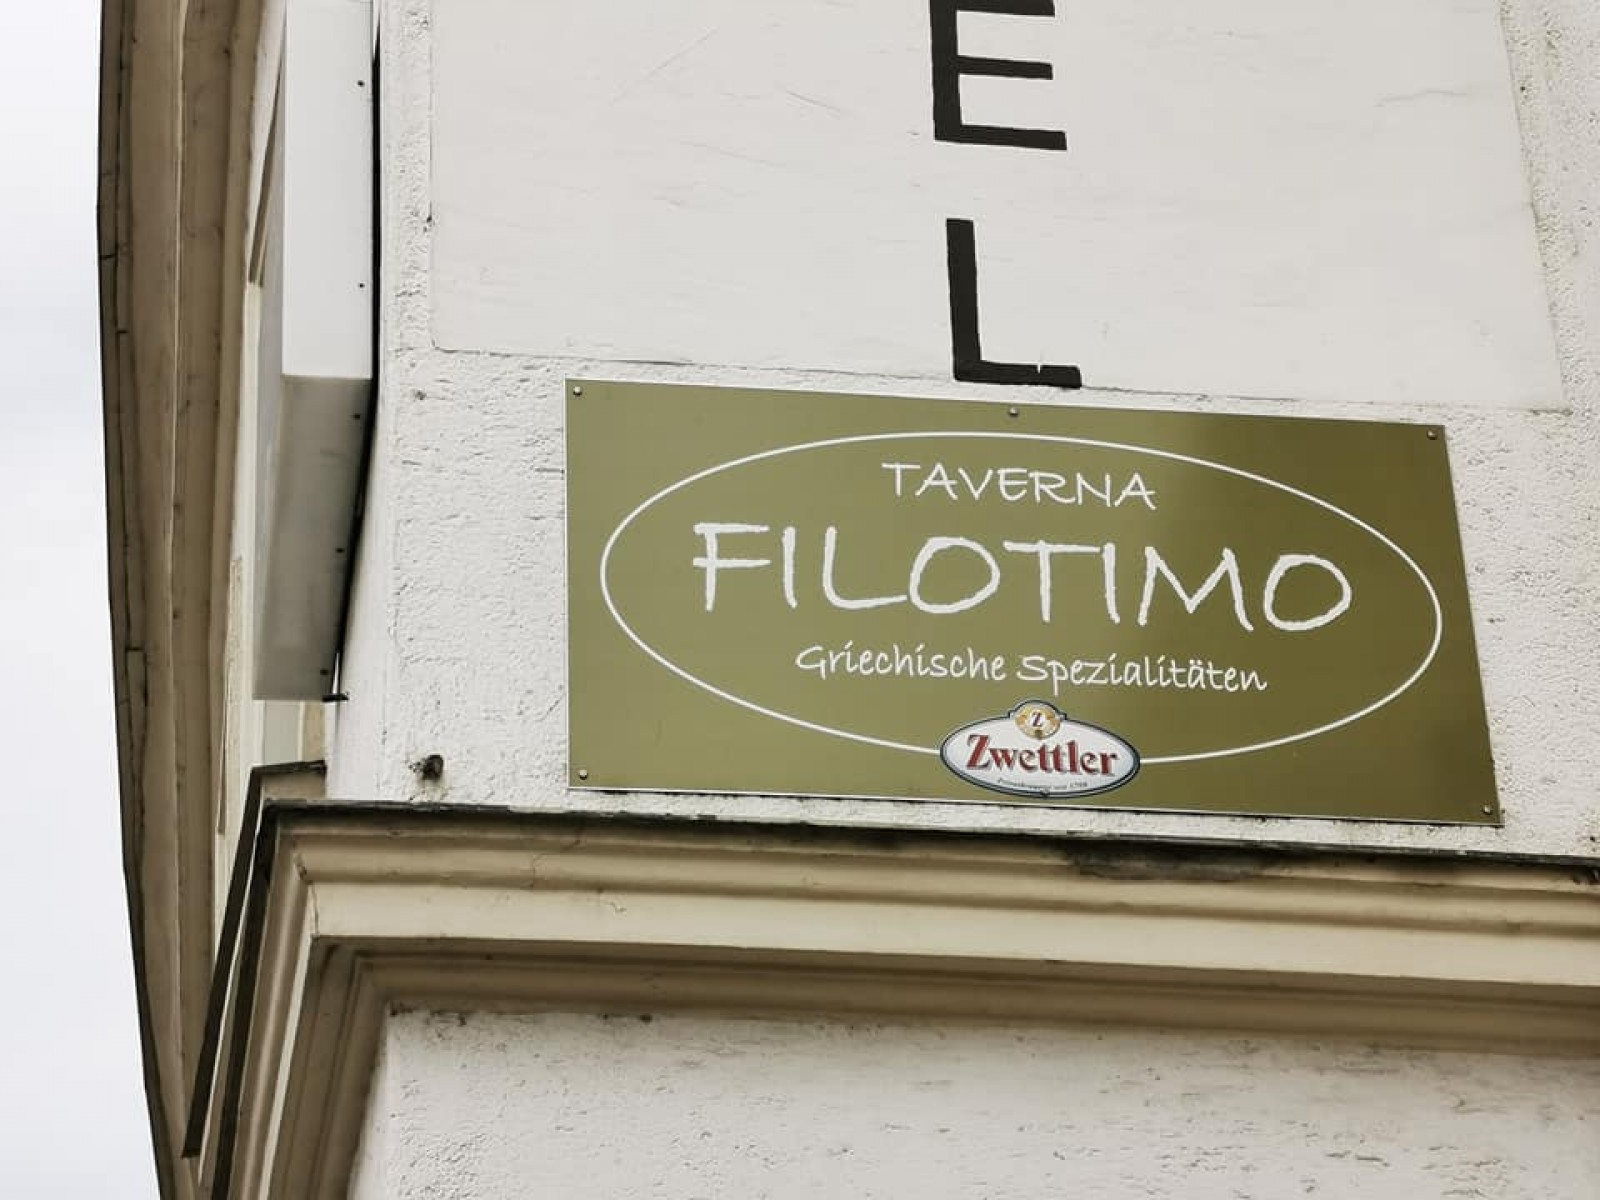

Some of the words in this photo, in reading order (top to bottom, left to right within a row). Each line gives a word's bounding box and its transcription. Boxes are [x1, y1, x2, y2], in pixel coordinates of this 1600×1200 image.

[881, 462, 1157, 511] TAVERNA
[692, 522, 1352, 632] FILOTIMO
[795, 640, 1006, 682] Griechische
[1016, 653, 1268, 696] Spezialitäten
[966, 734, 1120, 777] Zwettler
